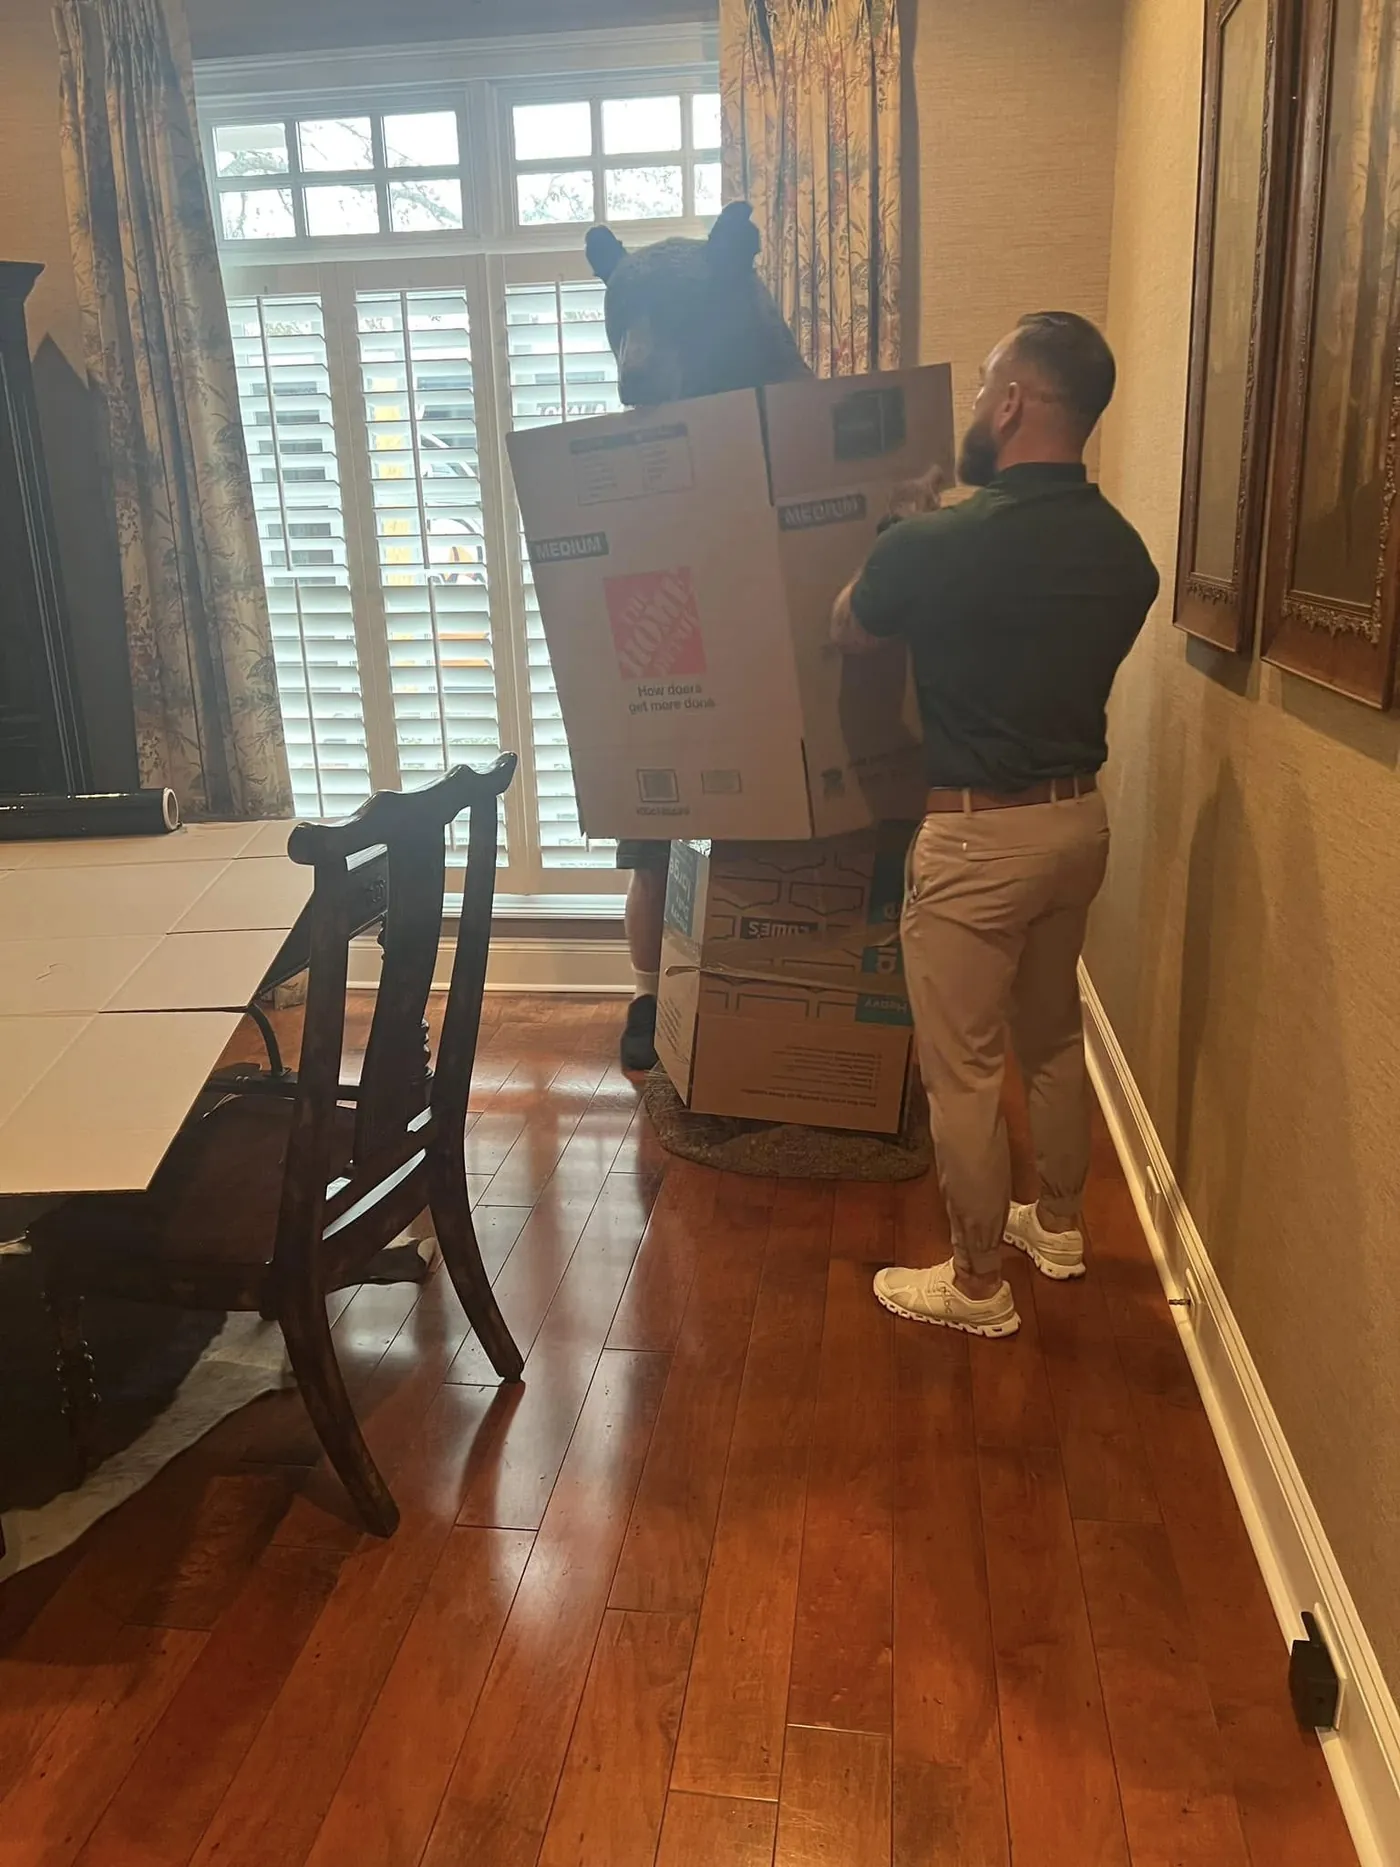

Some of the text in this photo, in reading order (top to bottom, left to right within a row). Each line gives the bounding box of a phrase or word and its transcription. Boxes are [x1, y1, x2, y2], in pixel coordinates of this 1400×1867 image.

[784, 498, 858, 525] MEDIUM
[535, 535, 602, 560] MEDIUM
[637, 682, 702, 697] How doers
[629, 696, 716, 715] get more done
